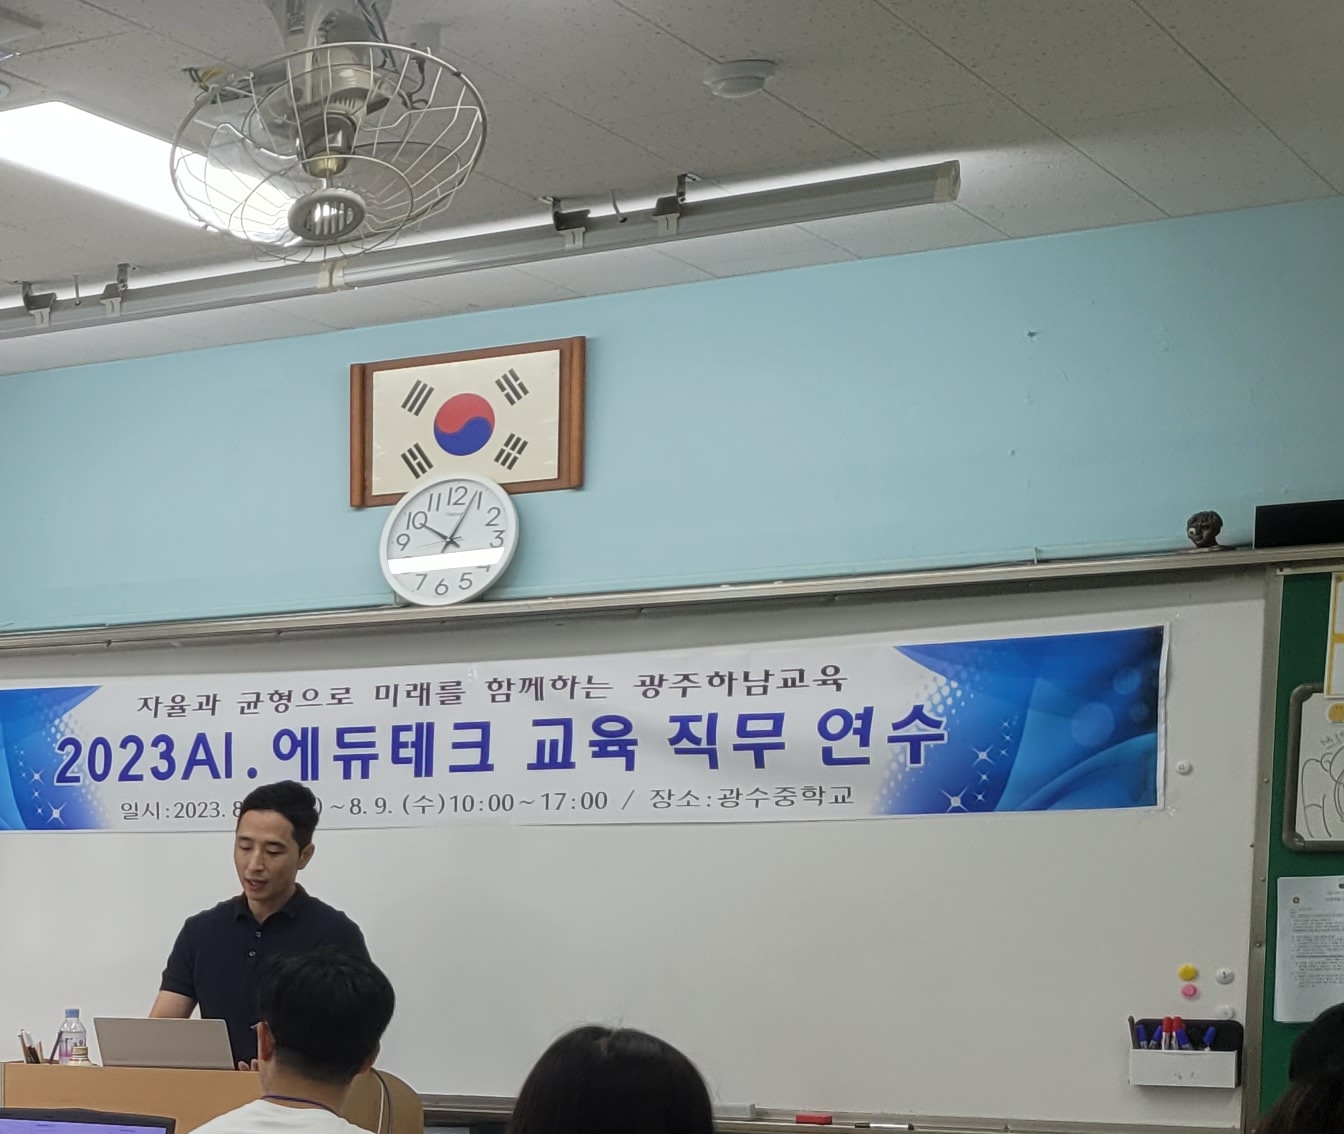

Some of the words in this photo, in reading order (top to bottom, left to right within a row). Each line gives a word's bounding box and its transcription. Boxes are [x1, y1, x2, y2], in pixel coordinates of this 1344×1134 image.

[428, 493, 442, 512] 11
[447, 486, 468, 506] 12
[406, 511, 428, 530] 10
[485, 507, 501, 526] 2
[396, 534, 411, 551] 9
[490, 530, 505, 548] 3
[415, 574, 428, 590] 7
[435, 578, 449, 595] 6
[458, 572, 473, 590] 5
[138, 692, 221, 719] 자율과
[239, 686, 354, 715] 균형으로
[375, 680, 465, 708] 미래를
[486, 674, 613, 703] 함께하는
[633, 664, 848, 699] 광주하남교육
[526, 714, 639, 772] 교육
[667, 712, 786, 770] 직무
[816, 704, 948, 767] 연수
[120, 800, 226, 821] 일시:2023.
[651, 784, 853, 812] 장소:광수중학교
